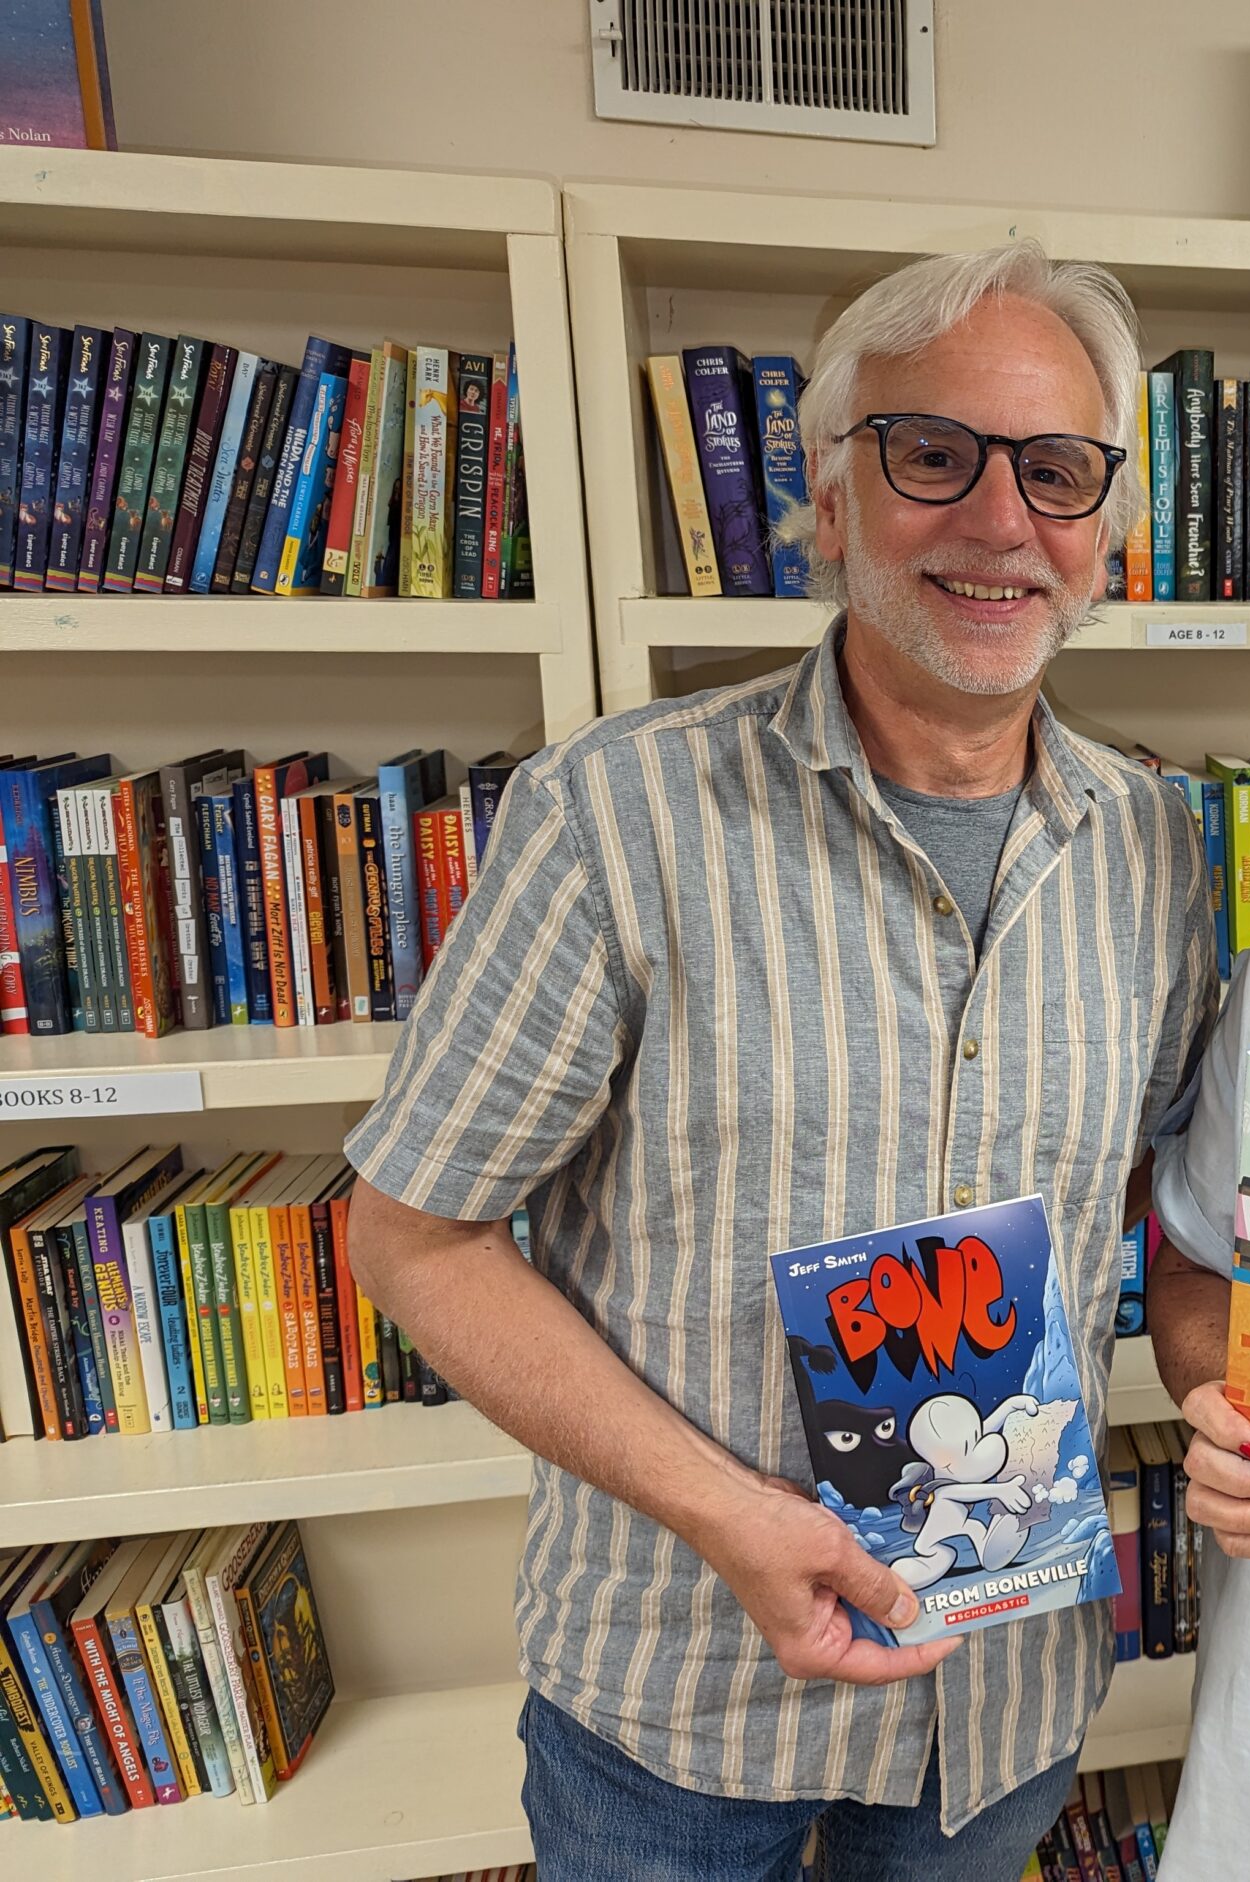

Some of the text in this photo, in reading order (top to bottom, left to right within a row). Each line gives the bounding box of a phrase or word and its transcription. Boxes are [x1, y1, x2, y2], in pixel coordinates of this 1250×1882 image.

[9, 128, 51, 142] Nolan
[432, 359, 440, 383] HENRY
[465, 361, 485, 373] AVI
[695, 366, 729, 376] COLFER
[696, 357, 724, 367] CHRIS
[761, 370, 786, 378] CHRIS
[759, 378, 790, 386] COLFER
[431, 415, 441, 436] What
[704, 410, 737, 435] LAND
[419, 435, 429, 452] How
[431, 448, 443, 472] Found
[705, 436, 741, 452] STORIES
[271, 425, 294, 507] HIDDEN PEOPLE
[277, 428, 308, 509] HILDA AND THE
[418, 461, 429, 483] Saved
[458, 423, 484, 519] CRISPIN
[1184, 388, 1206, 578] Anybody Here Seen Frenchie?
[183, 460, 208, 517] TREATMENT
[414, 490, 428, 520] Dragon
[429, 490, 440, 511] Corn
[428, 512, 439, 532] Maze
[1154, 483, 1172, 538] FOWL
[459, 538, 479, 546] CROSS
[1169, 630, 1193, 640] AGE
[1196, 630, 1202, 639] 8
[1213, 630, 1225, 639] 12
[362, 803, 371, 833] GUTMAN
[463, 797, 472, 833] HENKES
[1239, 789, 1249, 824] KORMAN
[201, 803, 213, 850] FLEISCHMAN
[259, 795, 279, 880] CARY FAGAN
[419, 817, 435, 860] DAISY
[14, 856, 41, 917] NIMBUS
[389, 825, 411, 949] the hungry place
[130, 867, 149, 977] THE HUNDRED DRESSES
[309, 910, 322, 945] eleven
[269, 902, 288, 1005] Mort Ziff Is Not Dead
[0, 1087, 118, 1107] OOKS 8-12
[93, 1207, 108, 1253] KEATING
[788, 1251, 868, 1278] JEFF SMITH
[1121, 1240, 1137, 1280] HATCH
[94, 1263, 113, 1312] GENIUS
[825, 1234, 1017, 1379] BONE
[284, 1311, 299, 1369] SABOTAGE
[924, 1558, 1089, 1615] FROM BONEVILLE
[956, 1595, 1029, 1622] SCHOLASTIC
[84, 1639, 101, 1666] WITH
[94, 1665, 108, 1688] THE
[1, 1674, 32, 1727] TOMBQUEST
[100, 1687, 121, 1724] MIGHT
[113, 1724, 125, 1739] OF
[29, 1740, 57, 1797] VALLEY OF KINGS
[117, 1741, 140, 1782] ANGELS
